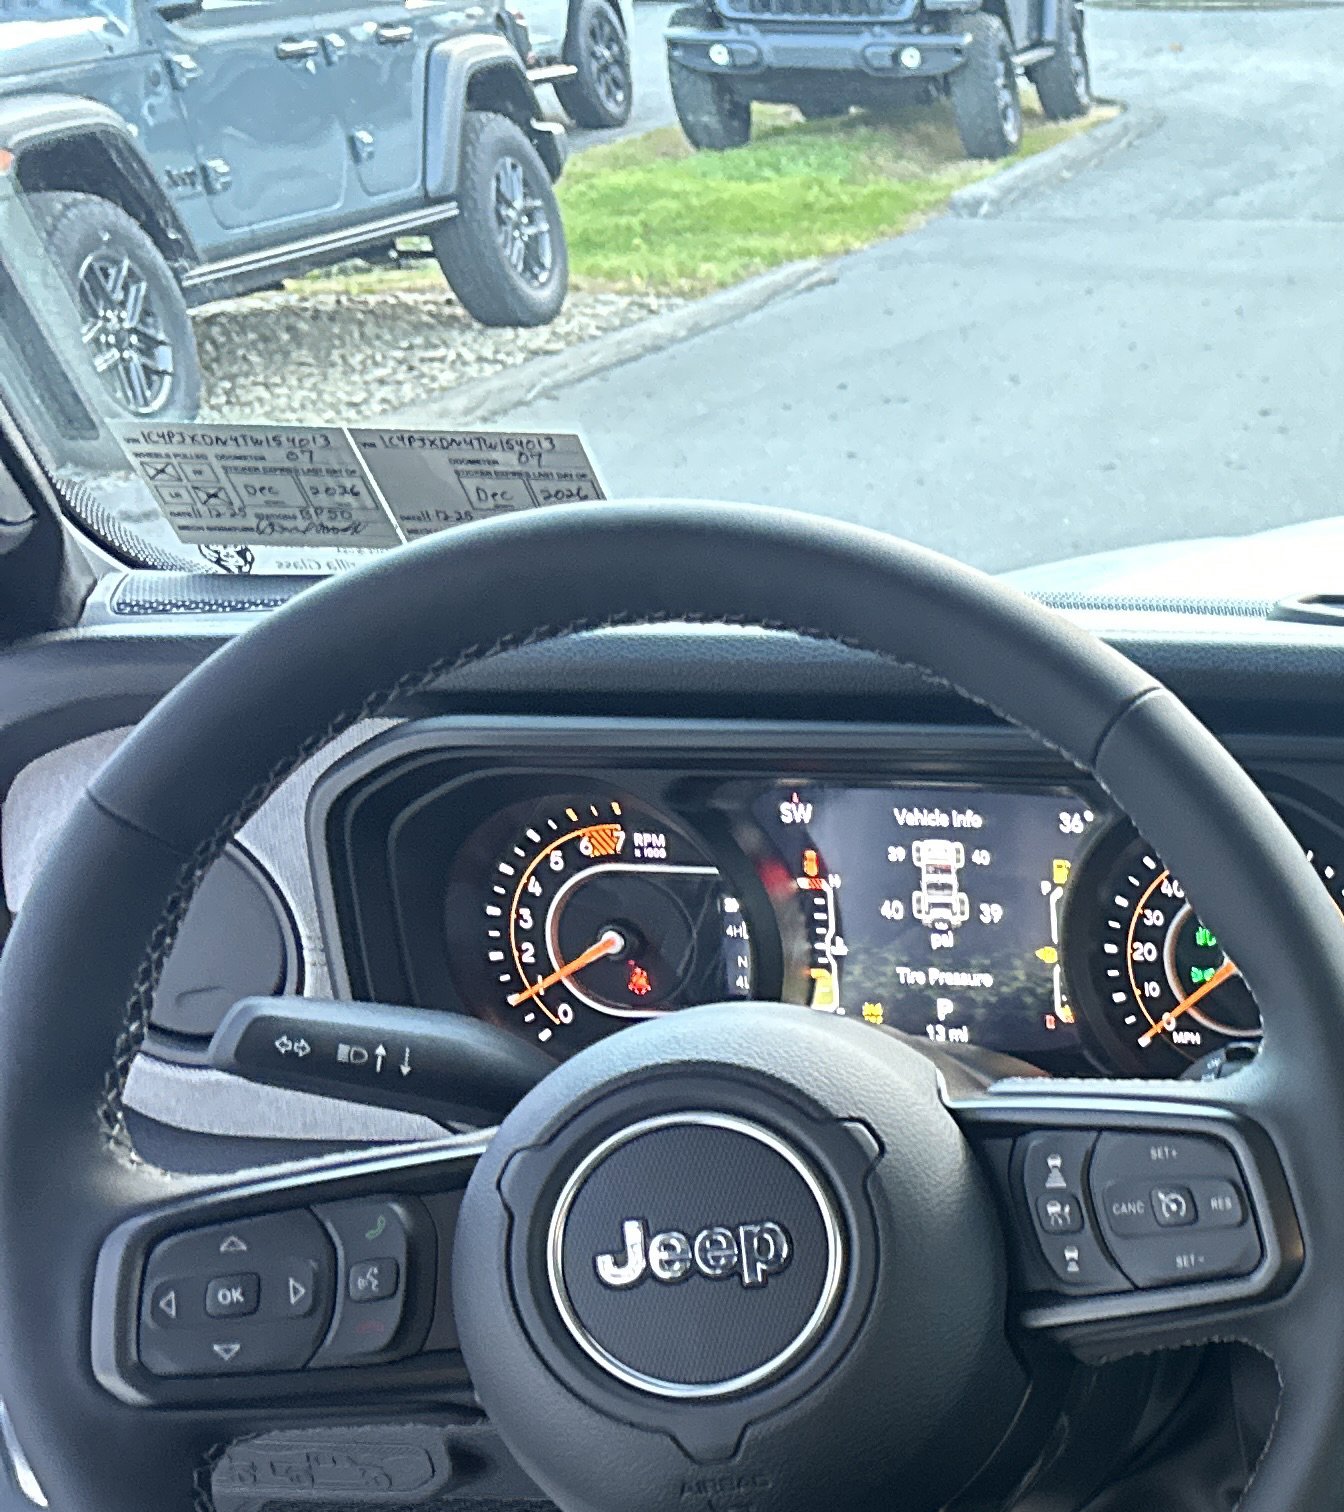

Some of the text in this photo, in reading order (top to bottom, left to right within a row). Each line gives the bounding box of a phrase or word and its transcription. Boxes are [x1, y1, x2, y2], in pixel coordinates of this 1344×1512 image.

[779, 801, 813, 825] SW
[893, 807, 950, 828] Vehicle
[579, 835, 593, 856] 6
[633, 832, 666, 848] RPM
[549, 850, 565, 872] 5
[527, 875, 543, 897] 4
[518, 907, 534, 930] 3
[880, 900, 904, 920] 40
[979, 903, 1003, 924] 39
[1143, 908, 1165, 927] 30
[521, 941, 536, 964] 2
[1132, 942, 1158, 962] 20
[895, 966, 994, 988] Tire Pressure
[1143, 981, 1161, 998] 10
[557, 1003, 574, 1025] 0
[936, 998, 954, 1021] P
[1172, 1031, 1201, 1046] MPH
[1112, 1200, 1145, 1216] CANC
[595, 1217, 794, 1288] Jeep
[217, 1287, 244, 1304] OK
